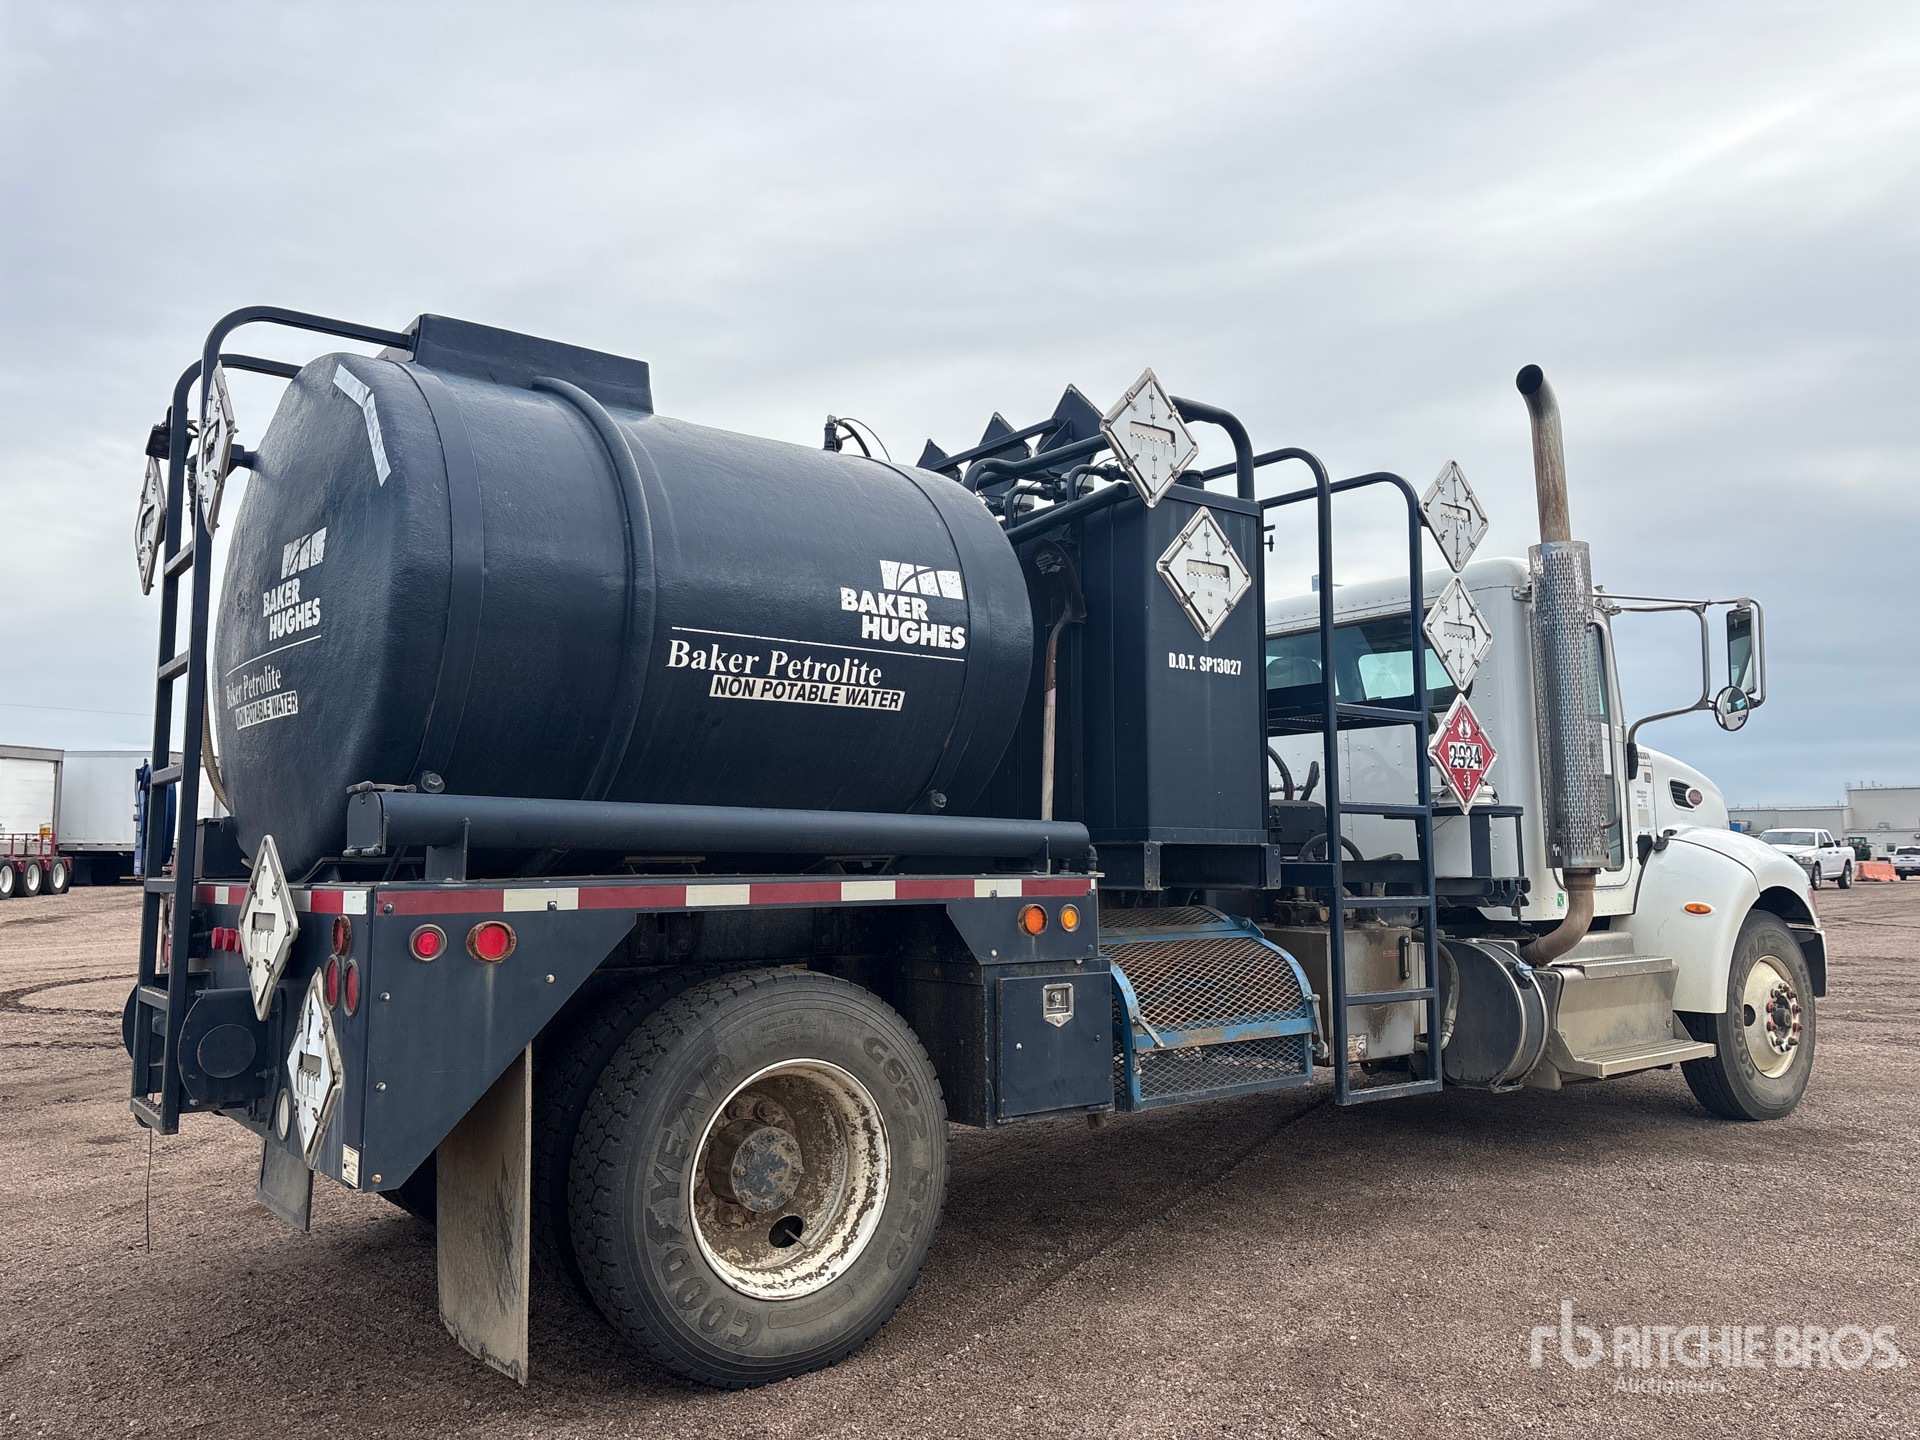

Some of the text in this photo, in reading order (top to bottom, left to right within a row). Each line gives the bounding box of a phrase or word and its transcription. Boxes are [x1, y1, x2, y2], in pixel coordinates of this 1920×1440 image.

[263, 578, 300, 617] BAKER
[840, 587, 929, 621] BAKER
[269, 598, 321, 641] HUGHES
[861, 615, 966, 650] HUGHES
[665, 639, 882, 686] Baker Petrolite
[1168, 652, 1242, 676] D.O.T. SP13027
[226, 664, 281, 710] Baker Petrolite
[714, 677, 901, 709] NON POTABLE WATER
[236, 692, 297, 727] NON POTABLE WATER
[1449, 744, 1482, 769] 2924
[863, 1038, 926, 1141] G622
[646, 1053, 761, 1347] GOODYEAR
